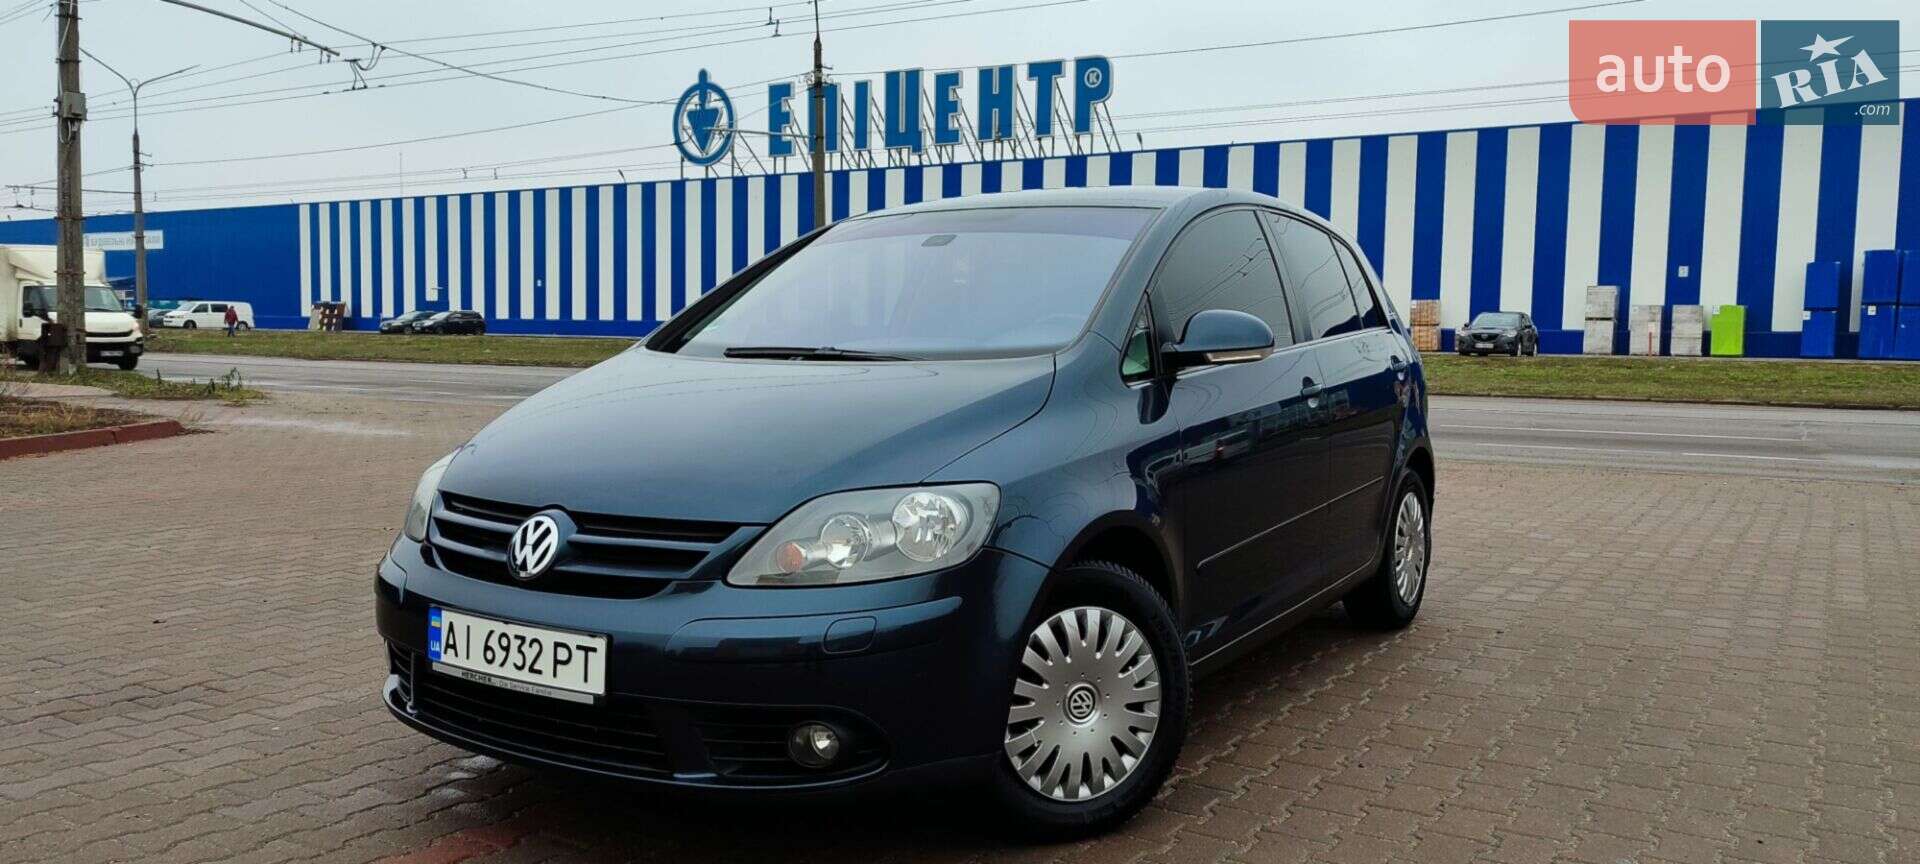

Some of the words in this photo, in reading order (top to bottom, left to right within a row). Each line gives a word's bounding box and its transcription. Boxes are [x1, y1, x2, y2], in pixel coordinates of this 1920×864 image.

[443, 621, 471, 661] AI
[483, 630, 543, 675] 6932
[553, 641, 598, 684] PT
